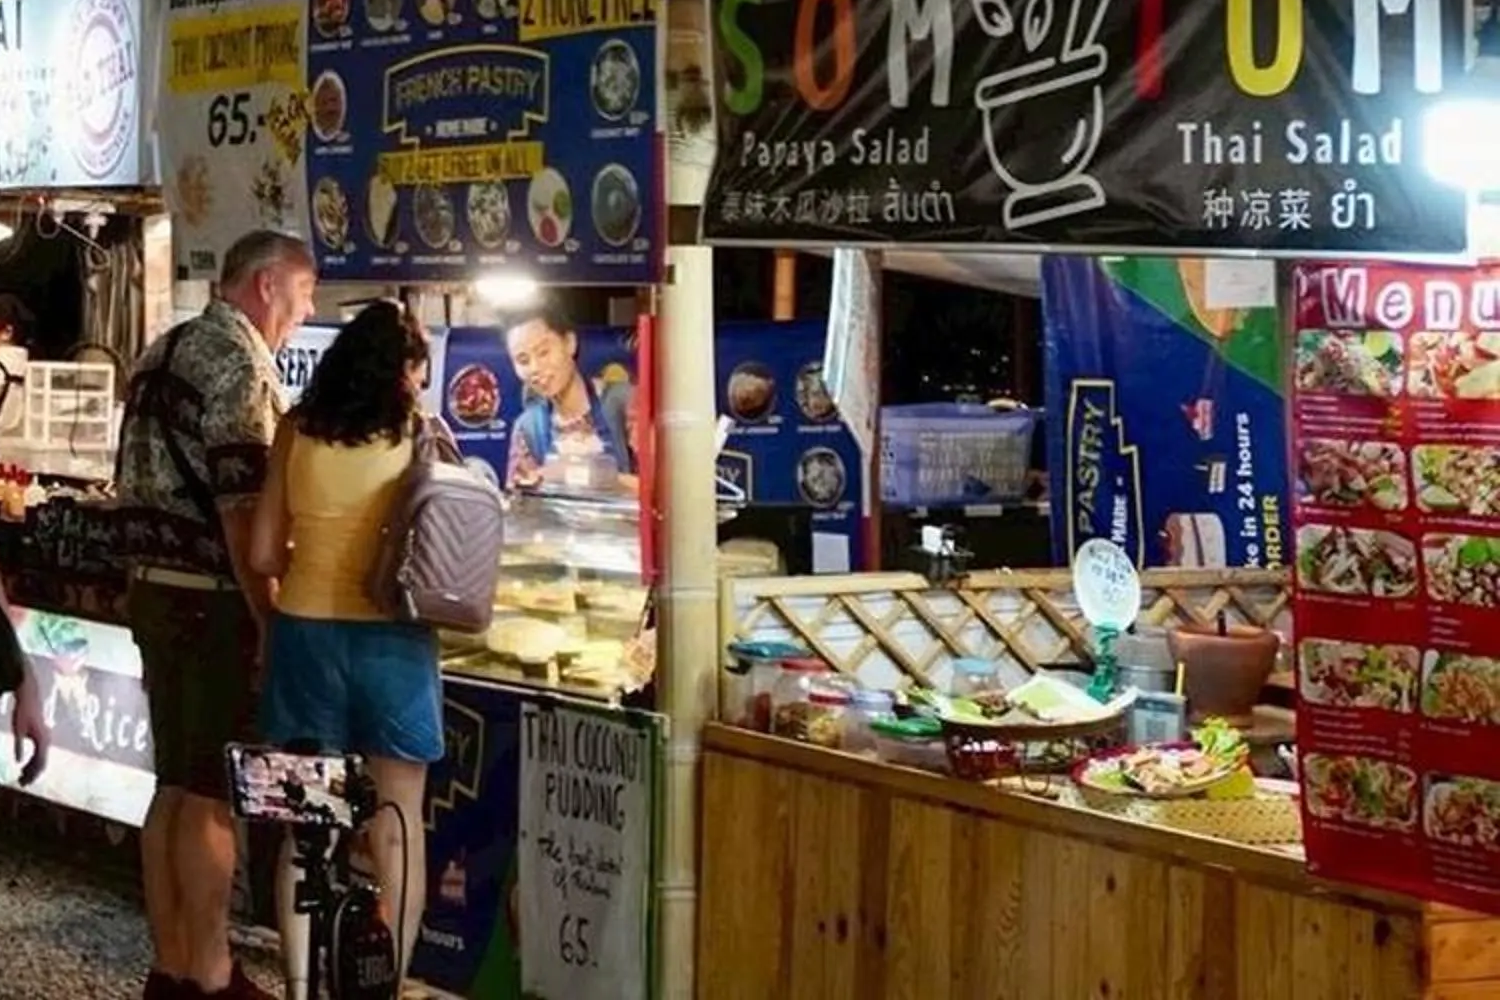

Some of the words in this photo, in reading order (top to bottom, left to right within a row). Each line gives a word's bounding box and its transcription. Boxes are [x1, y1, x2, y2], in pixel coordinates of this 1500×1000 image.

[467, 63, 540, 101] PASTRY
[741, 130, 837, 177] Papaya
[851, 126, 930, 165] Salad
[1177, 120, 1263, 164] Thai
[1285, 117, 1403, 164] Salad
[1203, 187, 1312, 230] 种凉菜
[1331, 178, 1376, 229] ยำ
[1321, 267, 1500, 330] Menu
[1078, 397, 1105, 535] PASTRY
[1236, 411, 1254, 477] hours
[1237, 483, 1255, 510] 24
[1240, 515, 1258, 537] in
[80, 693, 148, 752] Rice
[523, 706, 567, 769] THAI
[574, 720, 649, 785] COCONUT
[545, 773, 627, 833] PUDDING
